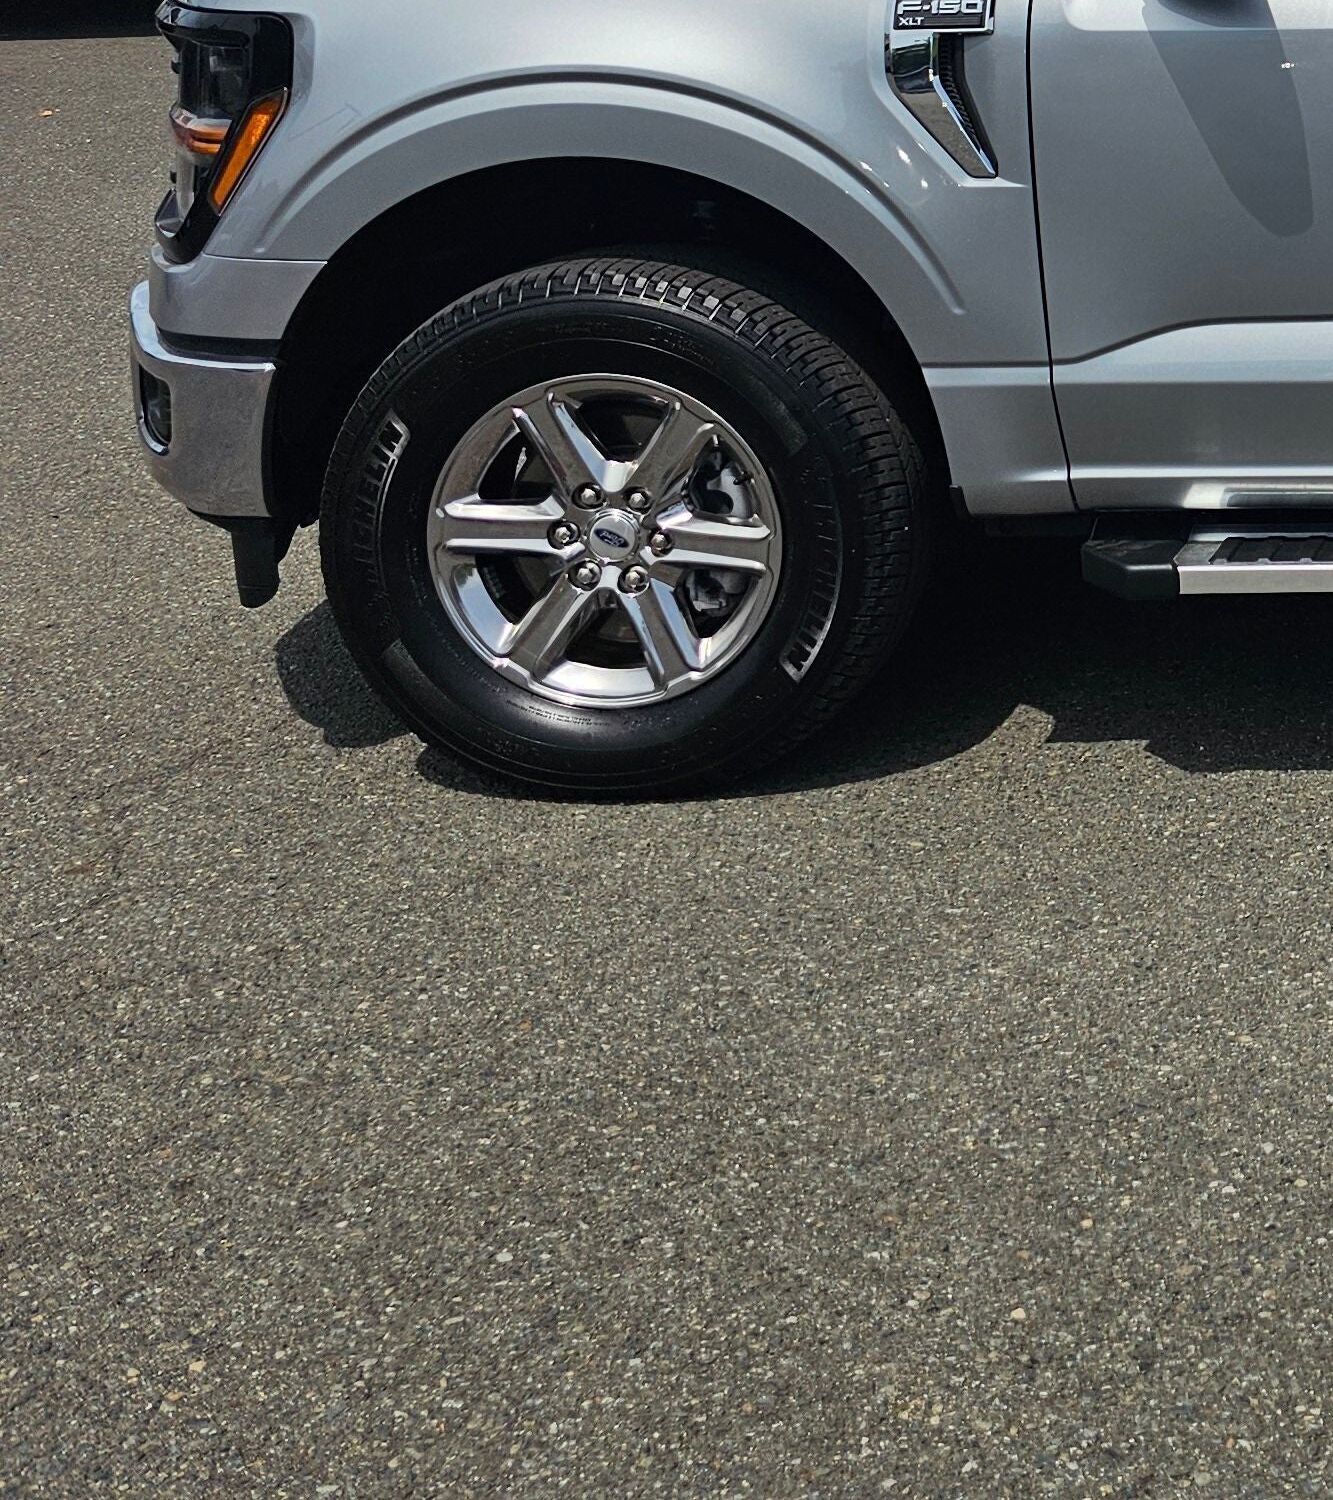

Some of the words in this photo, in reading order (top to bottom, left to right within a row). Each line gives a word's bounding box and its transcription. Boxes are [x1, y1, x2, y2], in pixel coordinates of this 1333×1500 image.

[897, 0, 984, 15] F-150
[898, 17, 924, 27] XLT
[600, 531, 625, 547] Ford
